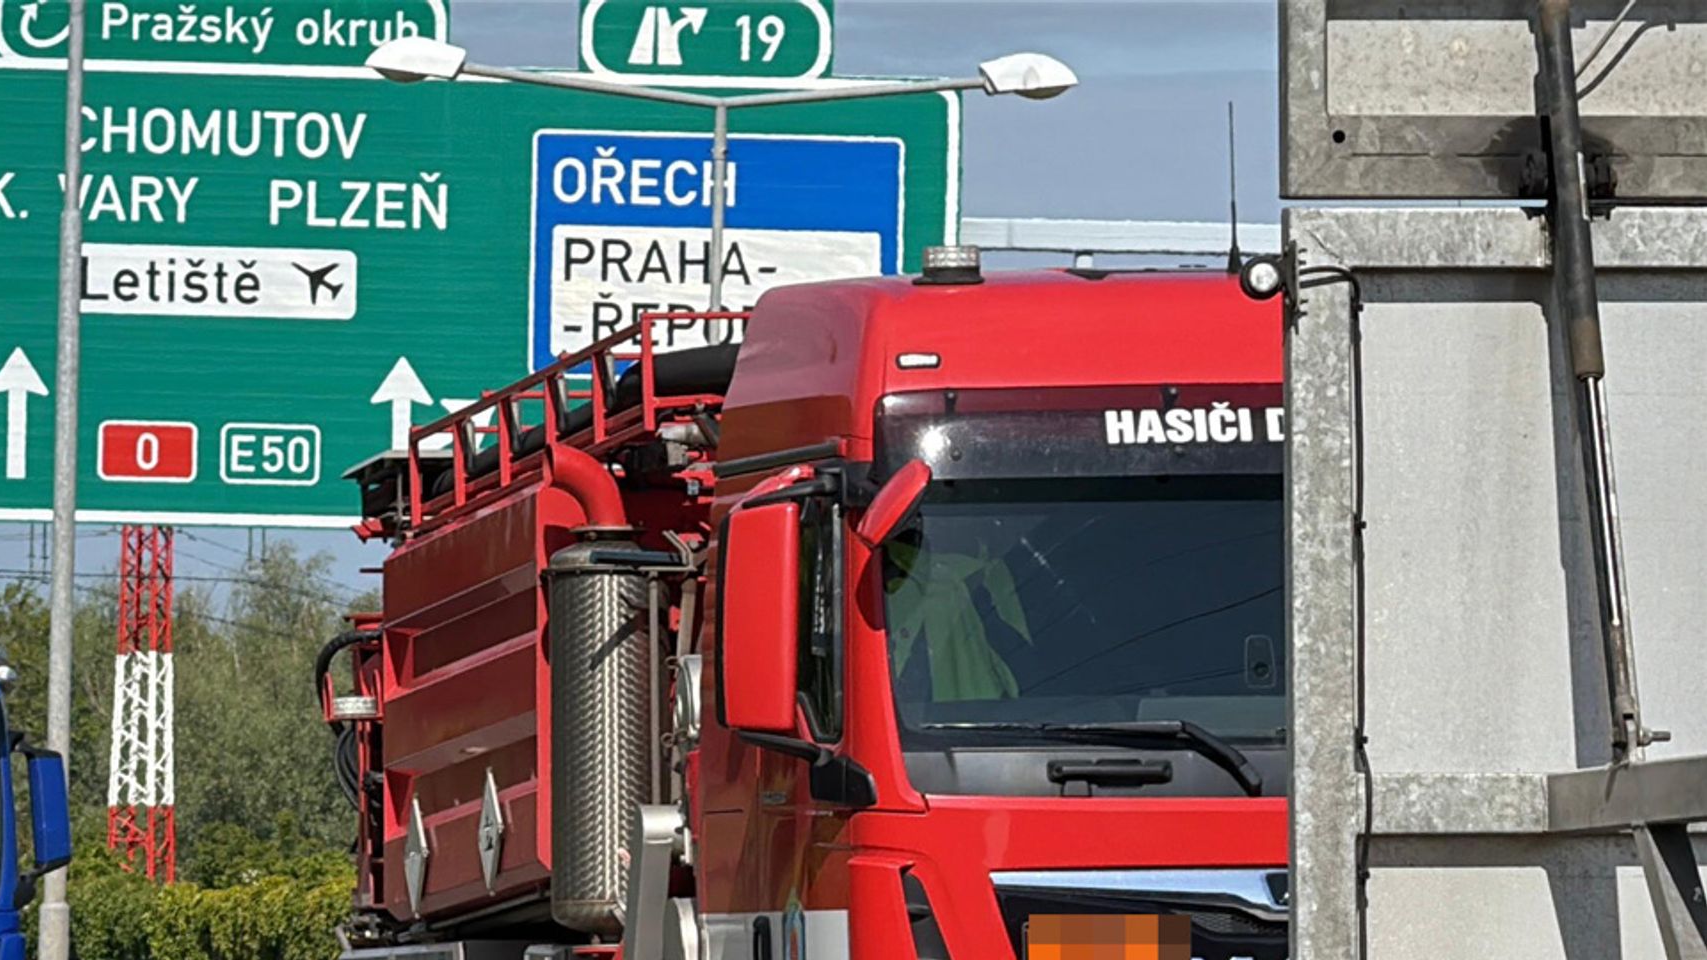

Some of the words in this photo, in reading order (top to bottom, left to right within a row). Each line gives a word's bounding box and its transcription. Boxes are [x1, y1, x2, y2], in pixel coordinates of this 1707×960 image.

[101, 2, 273, 53] Pražský
[297, 9, 420, 48] okruh
[735, 14, 785, 62] 19
[58, 174, 199, 222] VARY
[269, 171, 449, 230] PLZEŇ
[552, 146, 738, 207] OŘECH
[81, 258, 261, 305] Letiště
[563, 237, 777, 286] PRAHA-
[1105, 401, 1253, 444] HASIČI
[135, 432, 160, 471] 0
[230, 434, 310, 474] E50
